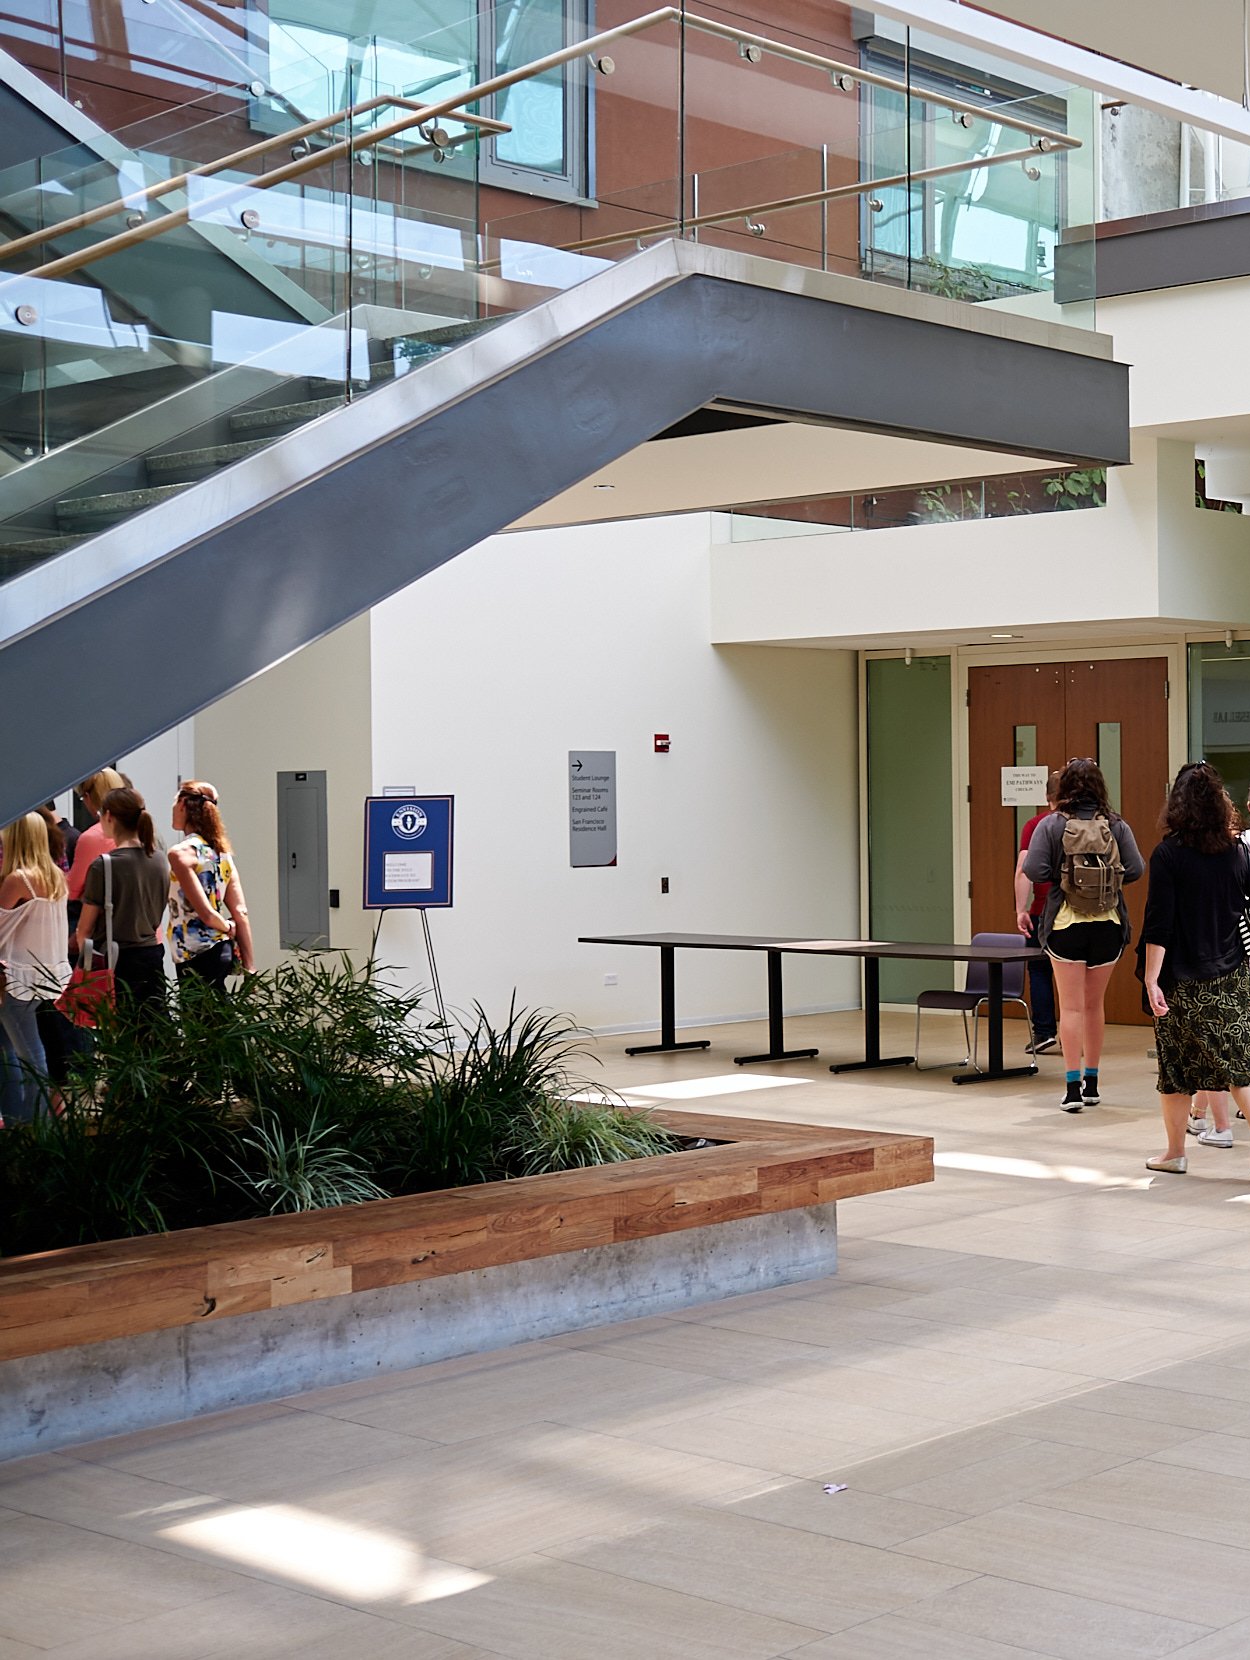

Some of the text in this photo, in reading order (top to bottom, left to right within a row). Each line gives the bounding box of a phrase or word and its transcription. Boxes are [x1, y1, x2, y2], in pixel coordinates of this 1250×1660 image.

[592, 775, 610, 783] Lounge
[395, 806, 423, 818] ENVISION
[571, 806, 596, 814] Engrained
